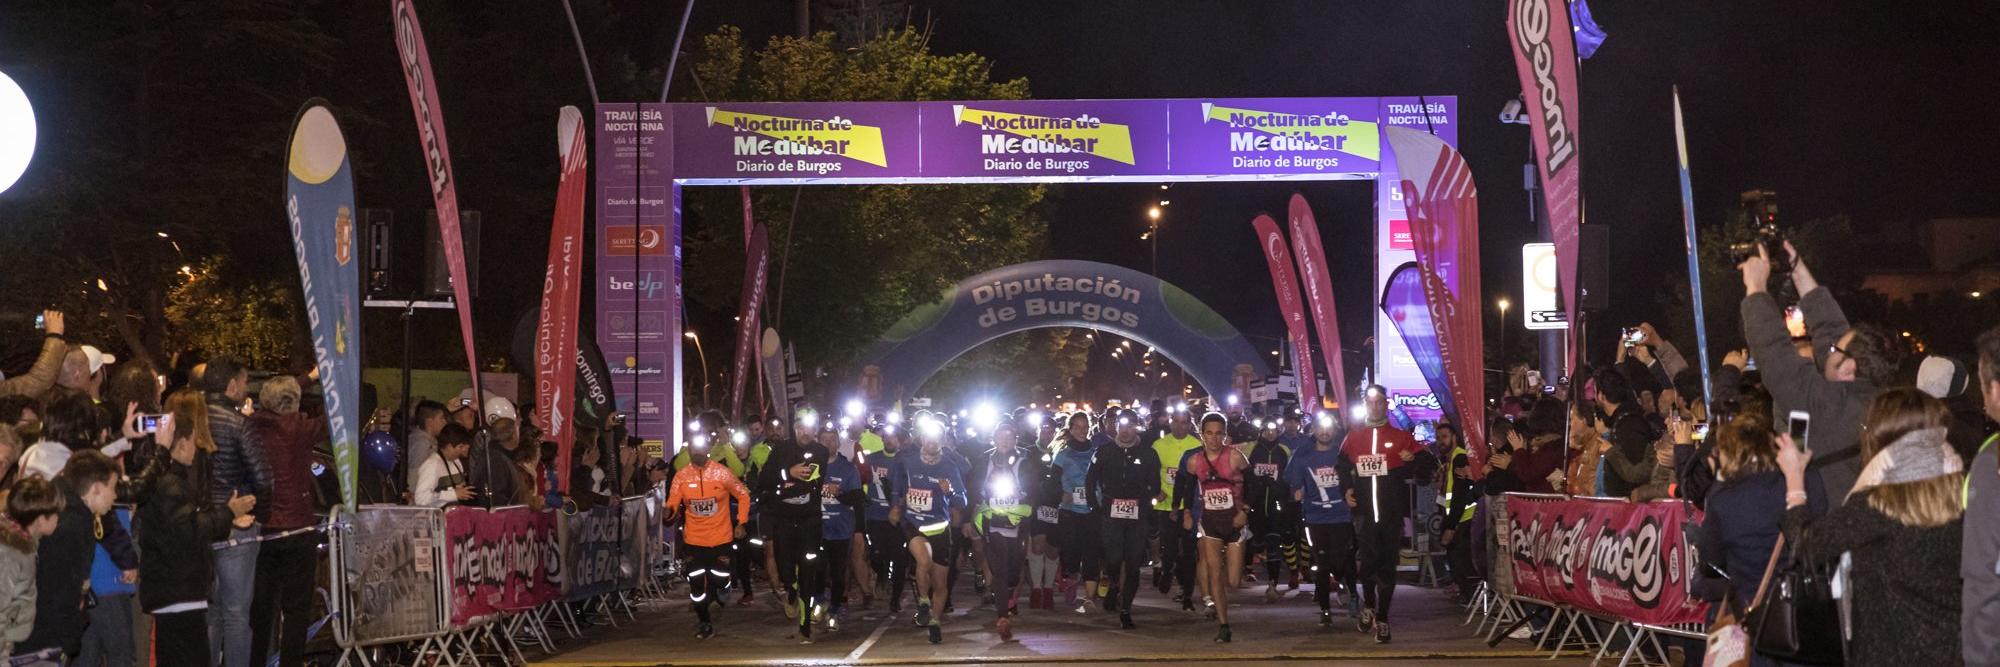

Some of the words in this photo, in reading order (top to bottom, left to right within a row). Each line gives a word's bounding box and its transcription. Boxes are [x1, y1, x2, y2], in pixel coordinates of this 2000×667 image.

[1388, 102, 1446, 114] TRAVESÍA
[604, 109, 662, 121] TRAVESÍA
[1230, 112, 1321, 128] Nocturna
[1325, 111, 1349, 127] de
[1388, 115, 1448, 125] NOCTURNA
[733, 116, 824, 132] Nocturna
[828, 115, 853, 131] de
[981, 114, 1072, 130] Nocturna
[1077, 113, 1100, 130] de
[736, 159, 775, 172] Diario
[777, 159, 794, 172] de
[797, 160, 842, 175] Burgos
[984, 157, 1023, 171] Diario
[1025, 157, 1042, 170] de
[1045, 158, 1090, 172] Burgos
[1232, 155, 1271, 168] Diario
[1274, 155, 1290, 168] de
[1294, 155, 1339, 170] Burgos
[607, 198, 627, 206] Diario
[639, 198, 664, 207] Burgos
[971, 273, 1141, 305] Diputación
[978, 306, 1017, 328] de
[1025, 297, 1140, 328] Burgos
[1361, 462, 1383, 471] 1167
[909, 495, 928, 505] 1111
[1208, 496, 1229, 505] 1799
[694, 503, 714, 512] 1847
[1116, 505, 1135, 513] 1421
